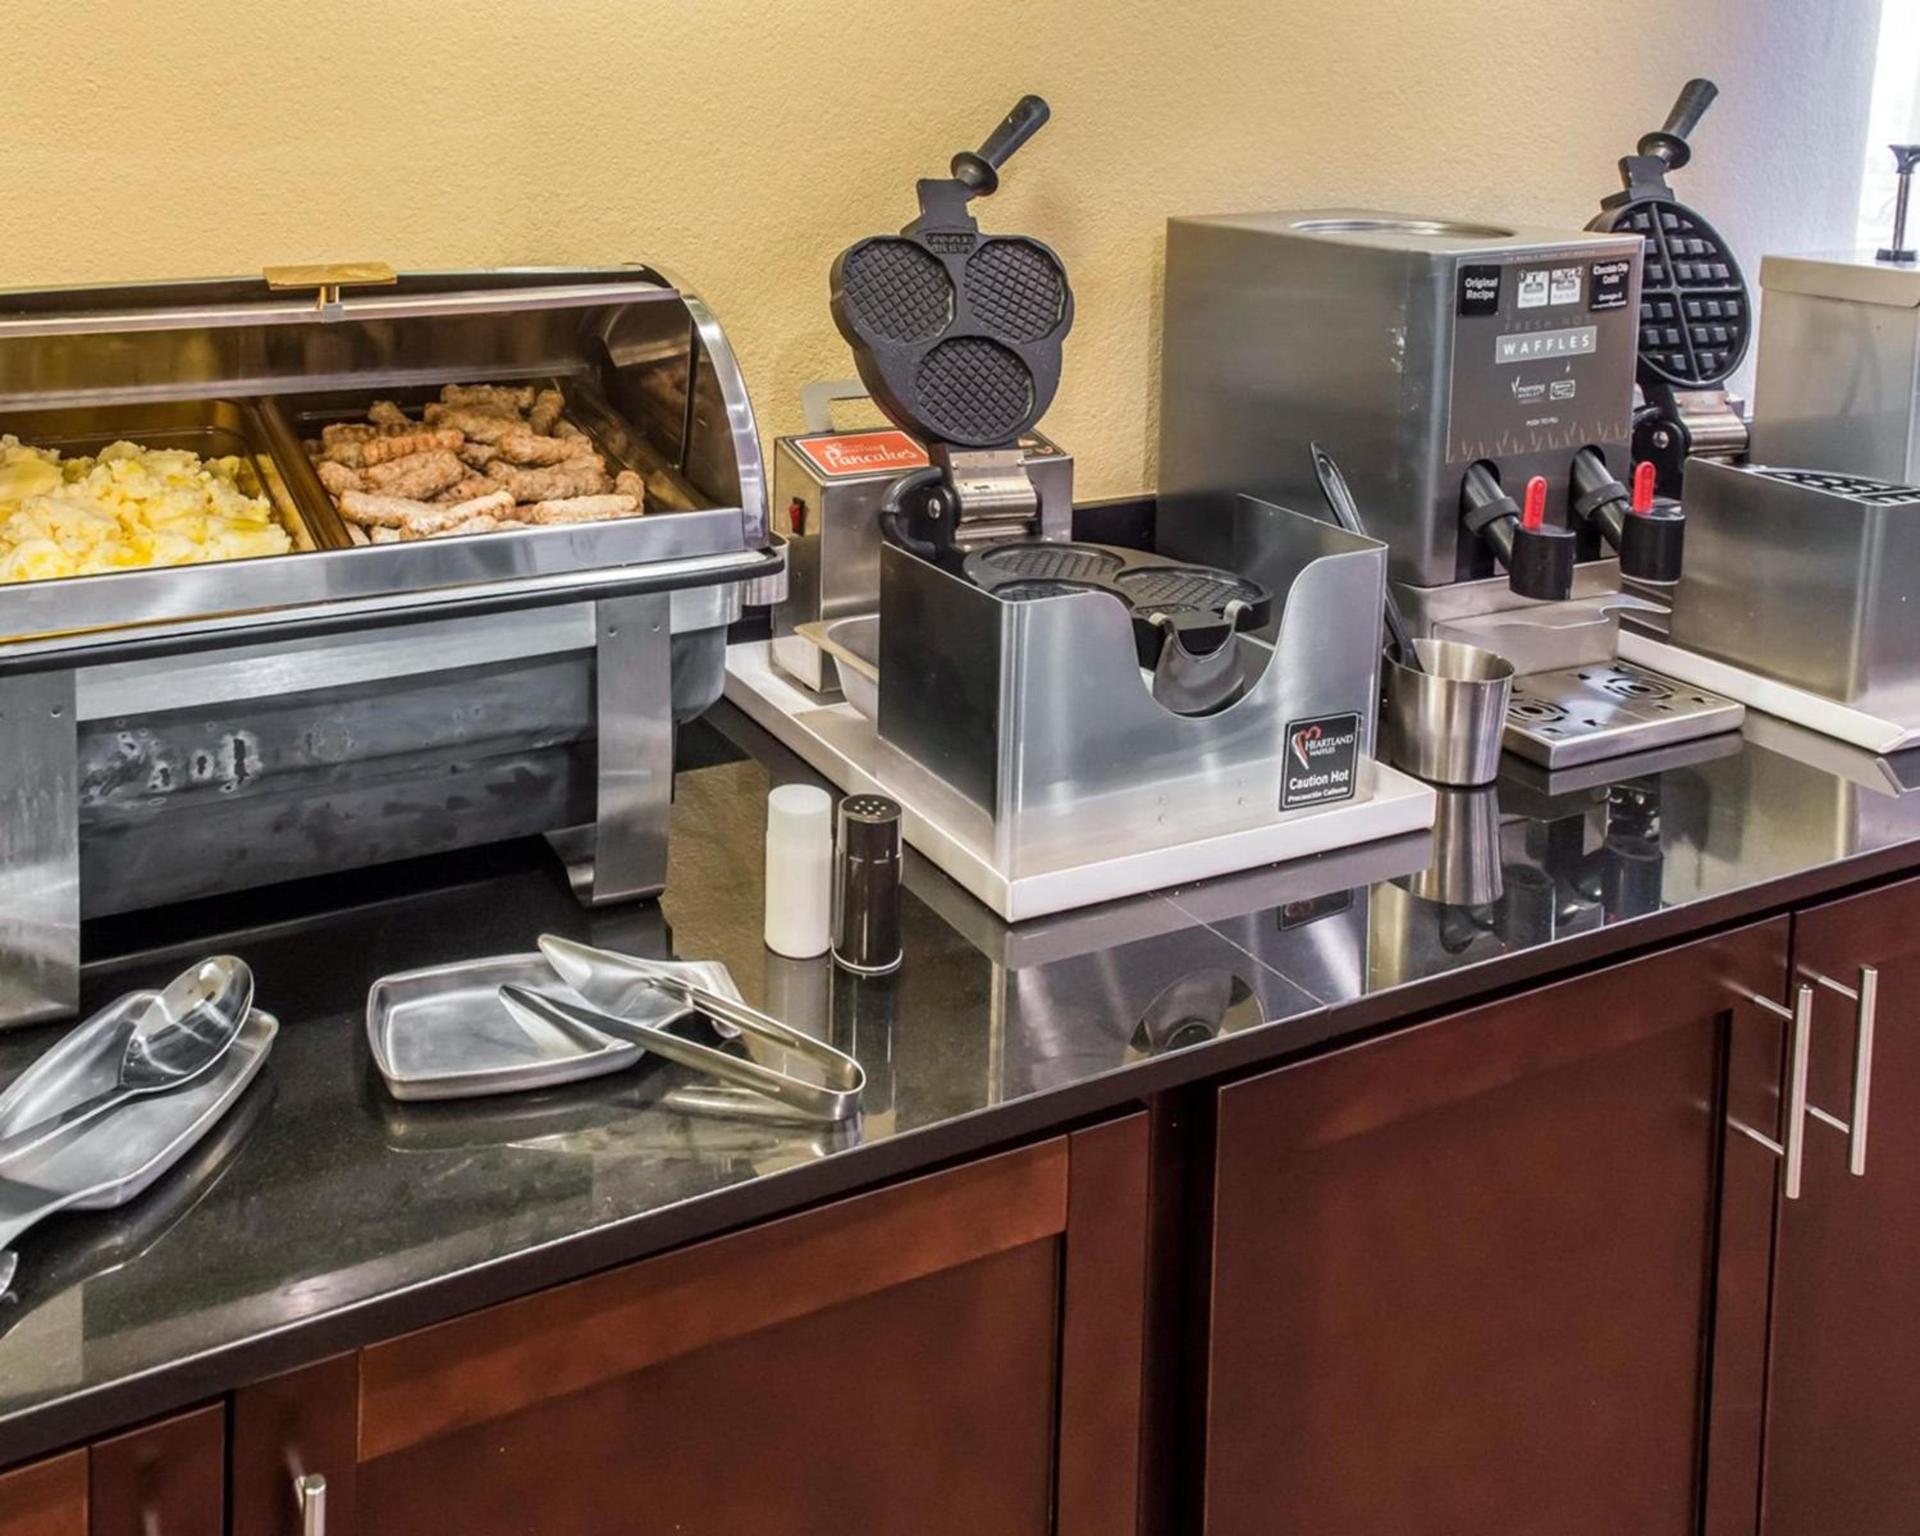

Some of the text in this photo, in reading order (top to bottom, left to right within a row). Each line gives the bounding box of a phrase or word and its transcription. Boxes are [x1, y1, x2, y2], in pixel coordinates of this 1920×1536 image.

[1465, 278, 1498, 290] Original
[1466, 289, 1495, 300] Recipe
[1504, 335, 1589, 355] WAFFLES
[825, 445, 917, 467] Pancakes
[1305, 734, 1354, 751] HEARTLAND
[1289, 769, 1349, 790] Caution Hot
